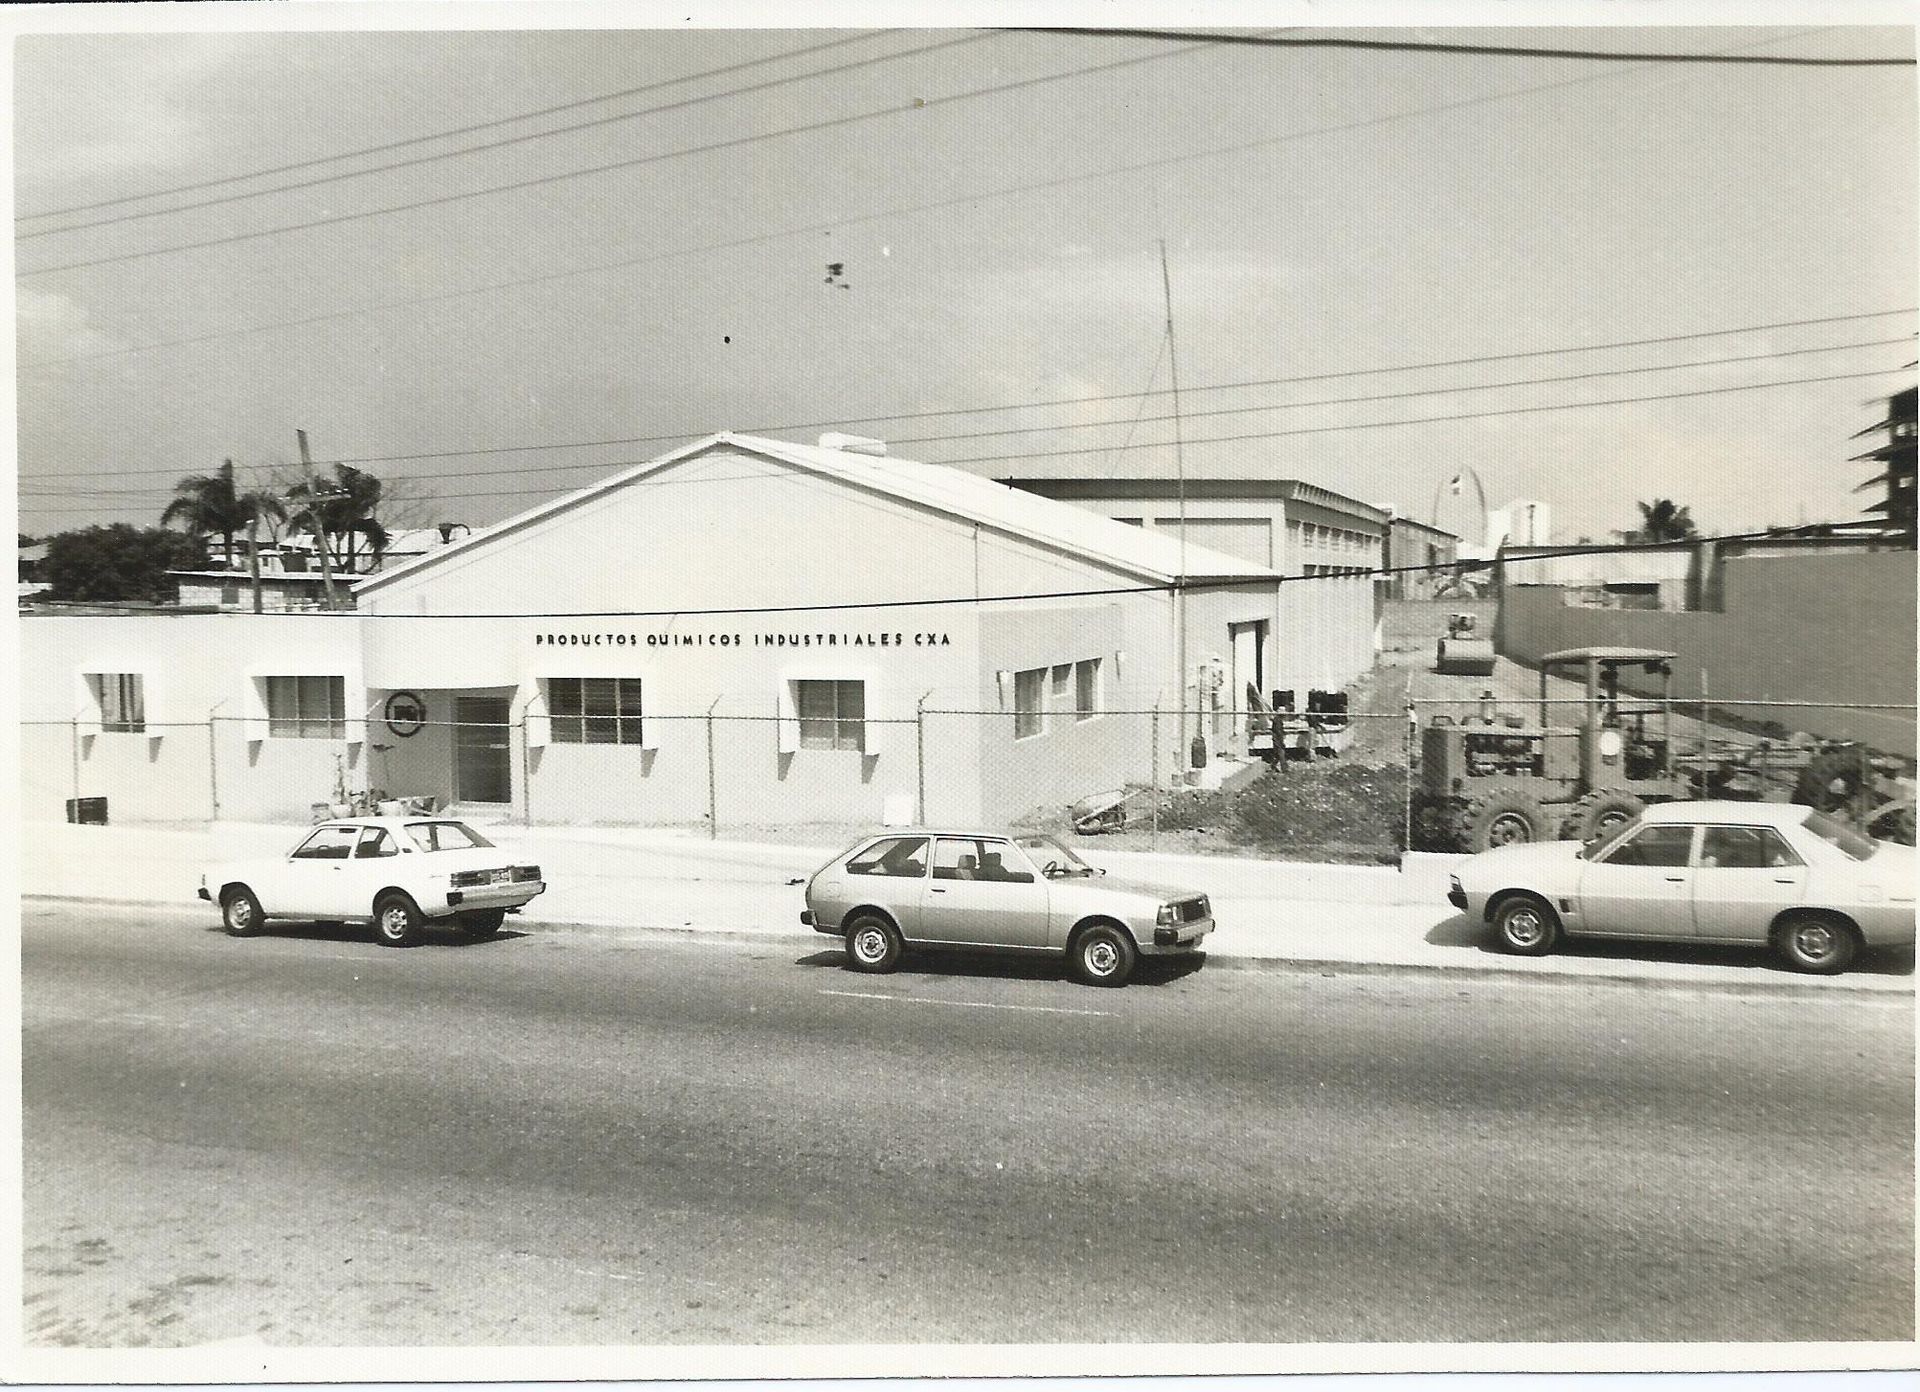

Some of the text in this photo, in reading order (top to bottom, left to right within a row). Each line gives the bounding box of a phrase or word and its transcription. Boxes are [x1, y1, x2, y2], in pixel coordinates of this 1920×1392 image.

[536, 632, 951, 647] PRODUCTOS QUIMICOS INDUSTRIALES CXA
